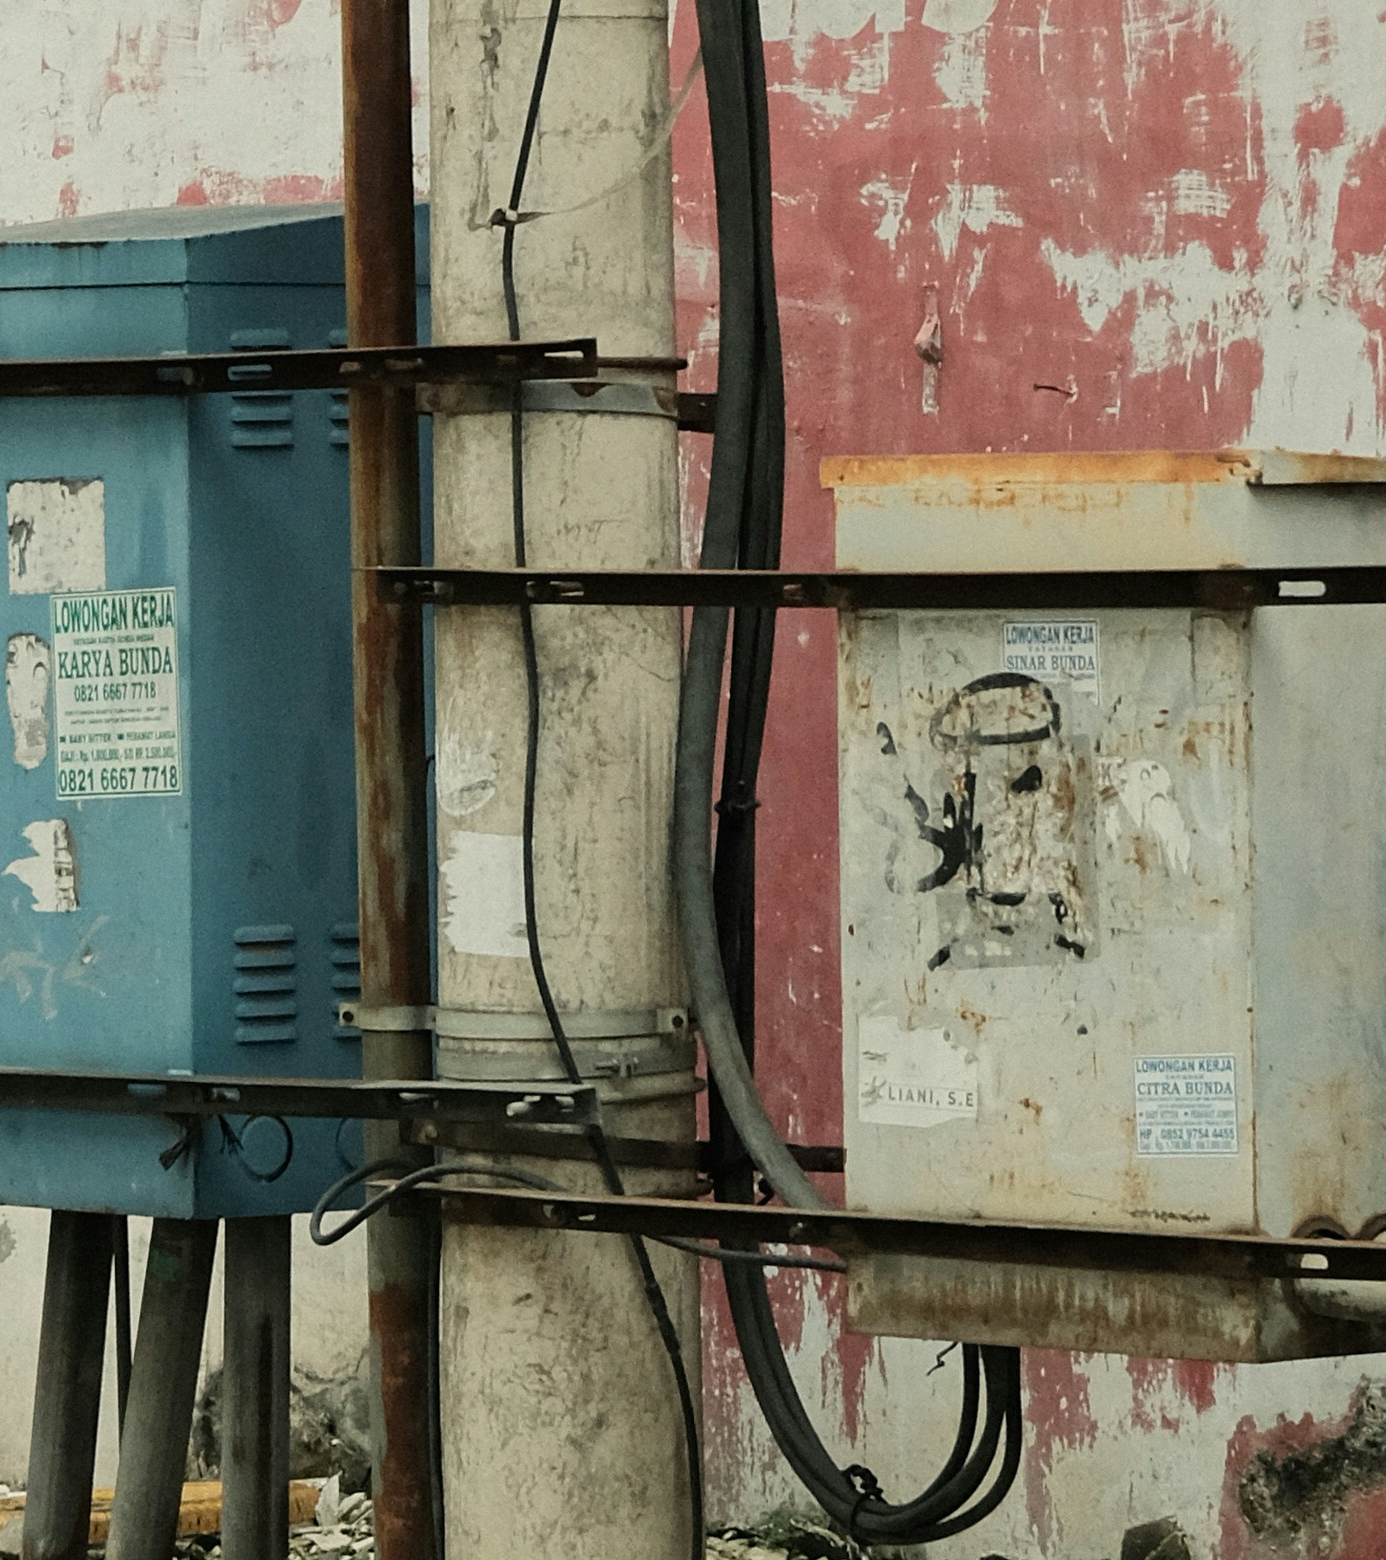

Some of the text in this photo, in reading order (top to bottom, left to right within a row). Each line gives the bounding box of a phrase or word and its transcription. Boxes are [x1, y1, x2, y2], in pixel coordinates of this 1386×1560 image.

[54, 593, 174, 633] LOWONGAN KERJA
[1006, 625, 1094, 645] LOWONGAN KERJA
[58, 646, 173, 679] KARYA BUNDA
[1006, 655, 1095, 671] SINAR BUNDA
[74, 681, 156, 703] 0821 6667 7718
[59, 765, 178, 792] 0821 6667 7718
[1135, 1058, 1233, 1073] LOWONGAN KERJA
[1137, 1081, 1233, 1095] CITRA BUNDA
